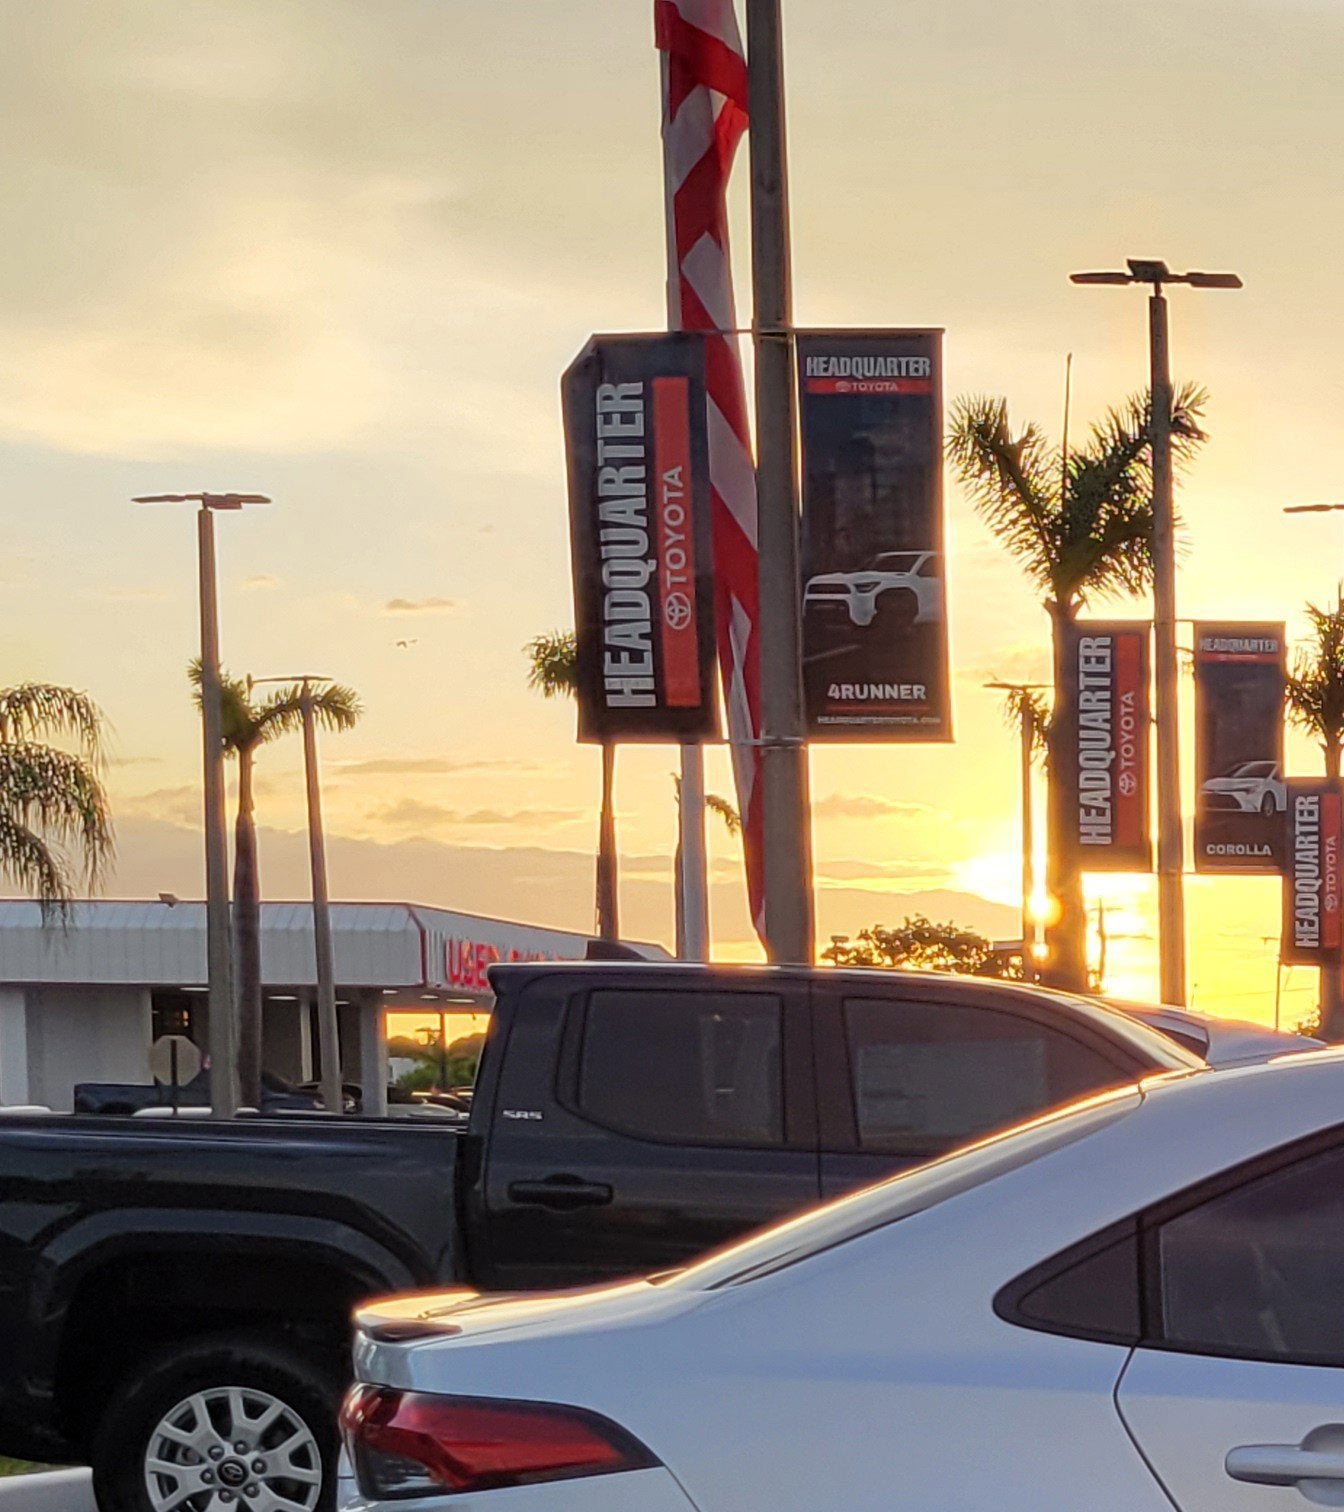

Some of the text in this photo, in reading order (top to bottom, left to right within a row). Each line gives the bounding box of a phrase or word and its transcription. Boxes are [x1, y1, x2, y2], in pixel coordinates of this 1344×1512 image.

[806, 356, 931, 379] HEADQUARTER
[852, 381, 899, 392] TOYOTA
[596, 381, 657, 707] HEADQUARTER
[662, 465, 689, 588] TOYOTA
[827, 683, 926, 700] 4RUNNER
[1079, 636, 1115, 845] HEADQUARTER
[1120, 691, 1136, 770] TOYOTA
[1206, 843, 1273, 856] COROLLA
[1295, 796, 1322, 948] HEADQUARTER
[1325, 835, 1337, 893] TOYOTA
